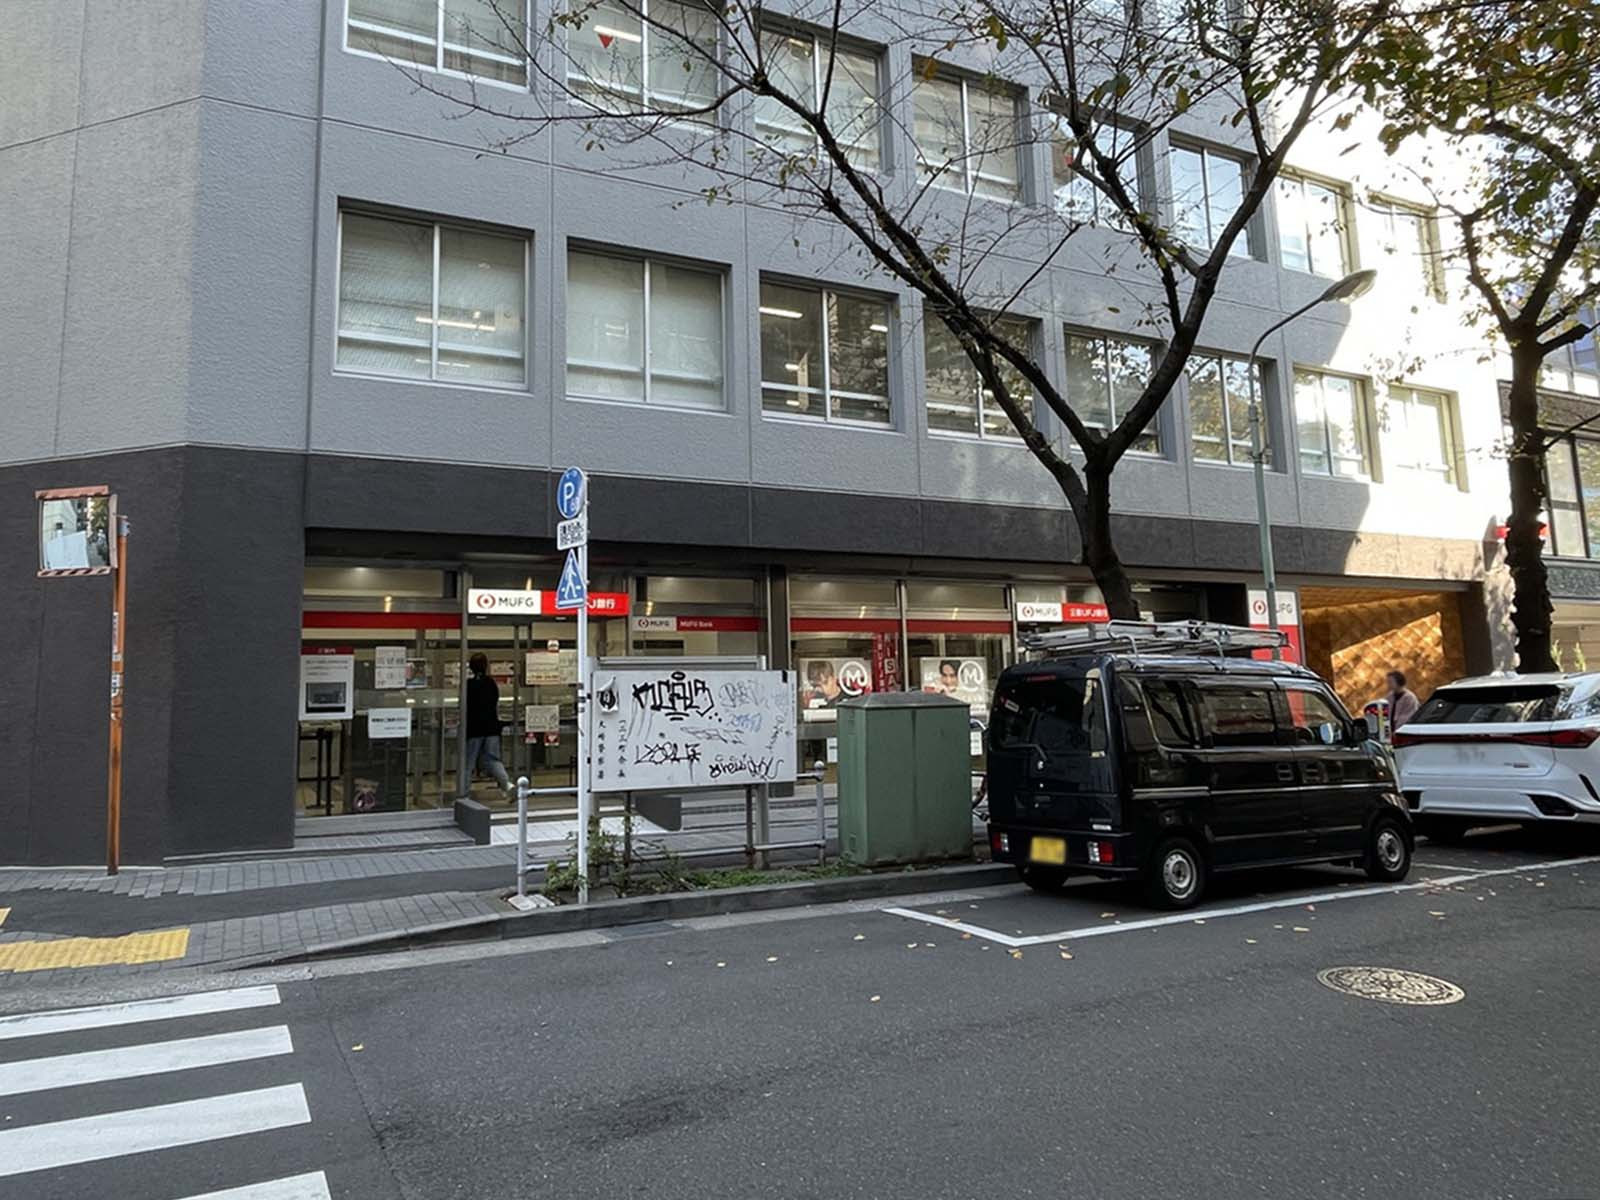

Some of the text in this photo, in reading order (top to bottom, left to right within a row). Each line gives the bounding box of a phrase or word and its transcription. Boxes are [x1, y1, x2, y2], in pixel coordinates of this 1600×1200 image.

[564, 482, 575, 513] P
[498, 596, 534, 608] MUFG
[1035, 607, 1058, 617] MUFG
